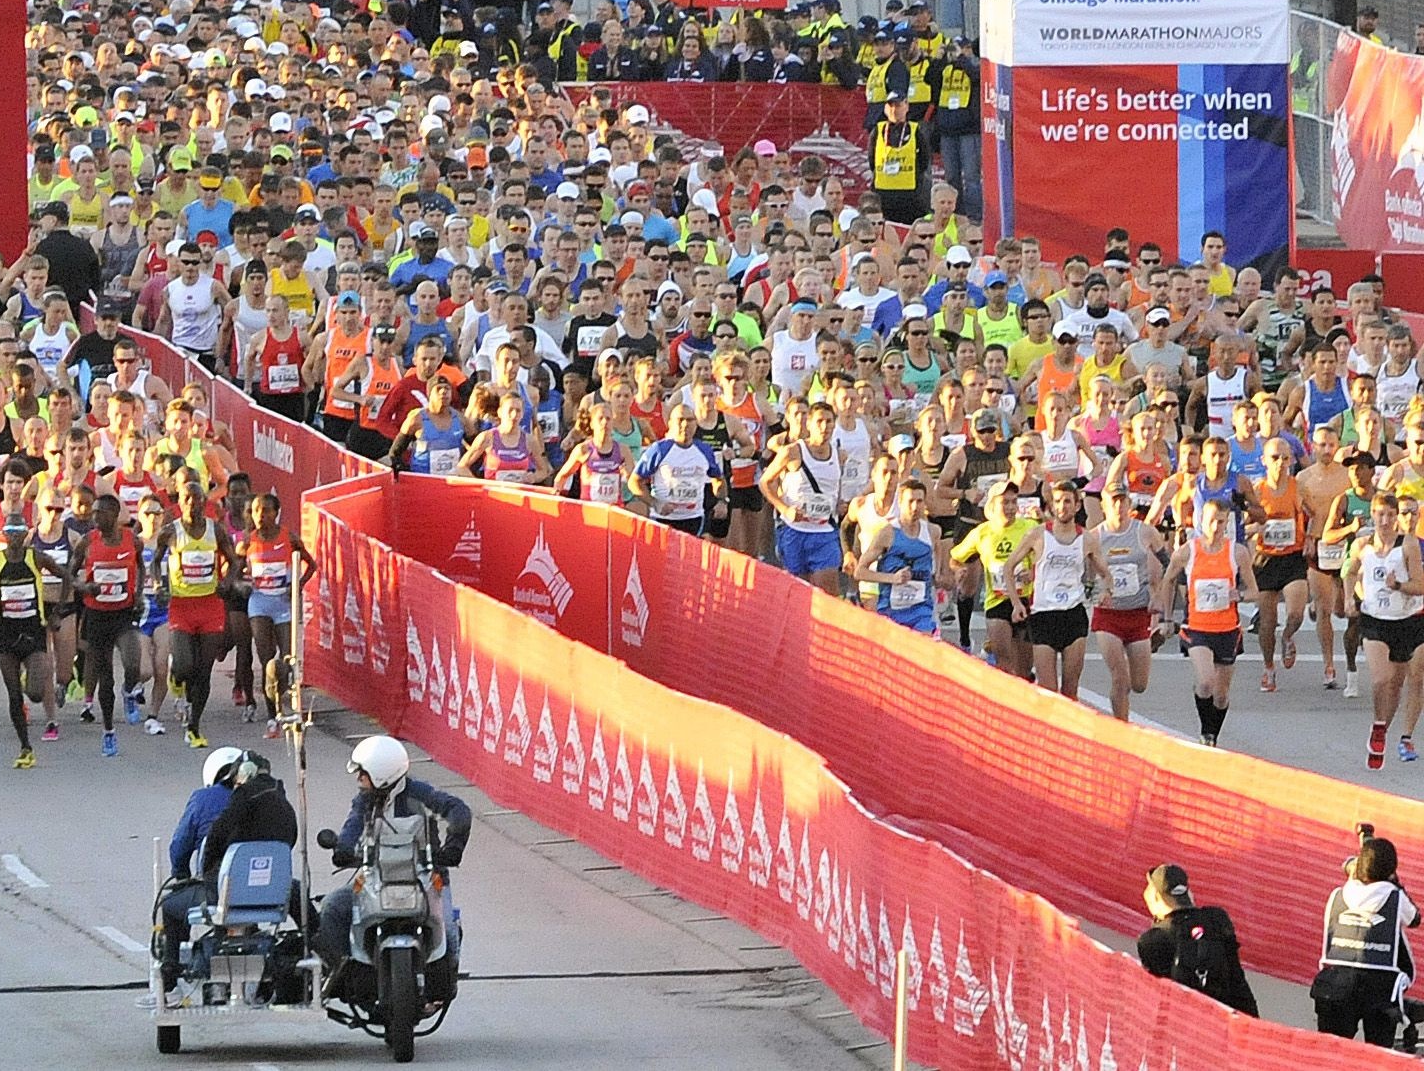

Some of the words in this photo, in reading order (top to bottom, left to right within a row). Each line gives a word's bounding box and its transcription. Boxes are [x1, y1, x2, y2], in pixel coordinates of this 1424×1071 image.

[1040, 25, 1263, 41] WORLDMARATHONMAJORS
[1041, 87, 1109, 112] Life's
[1117, 87, 1200, 112] better
[1203, 87, 1272, 111] when
[1040, 120, 1109, 142] we're
[1117, 116, 1249, 142] connected
[996, 541, 1013, 554] 42
[1331, 937, 1391, 952] PHOTOGRAPHER
